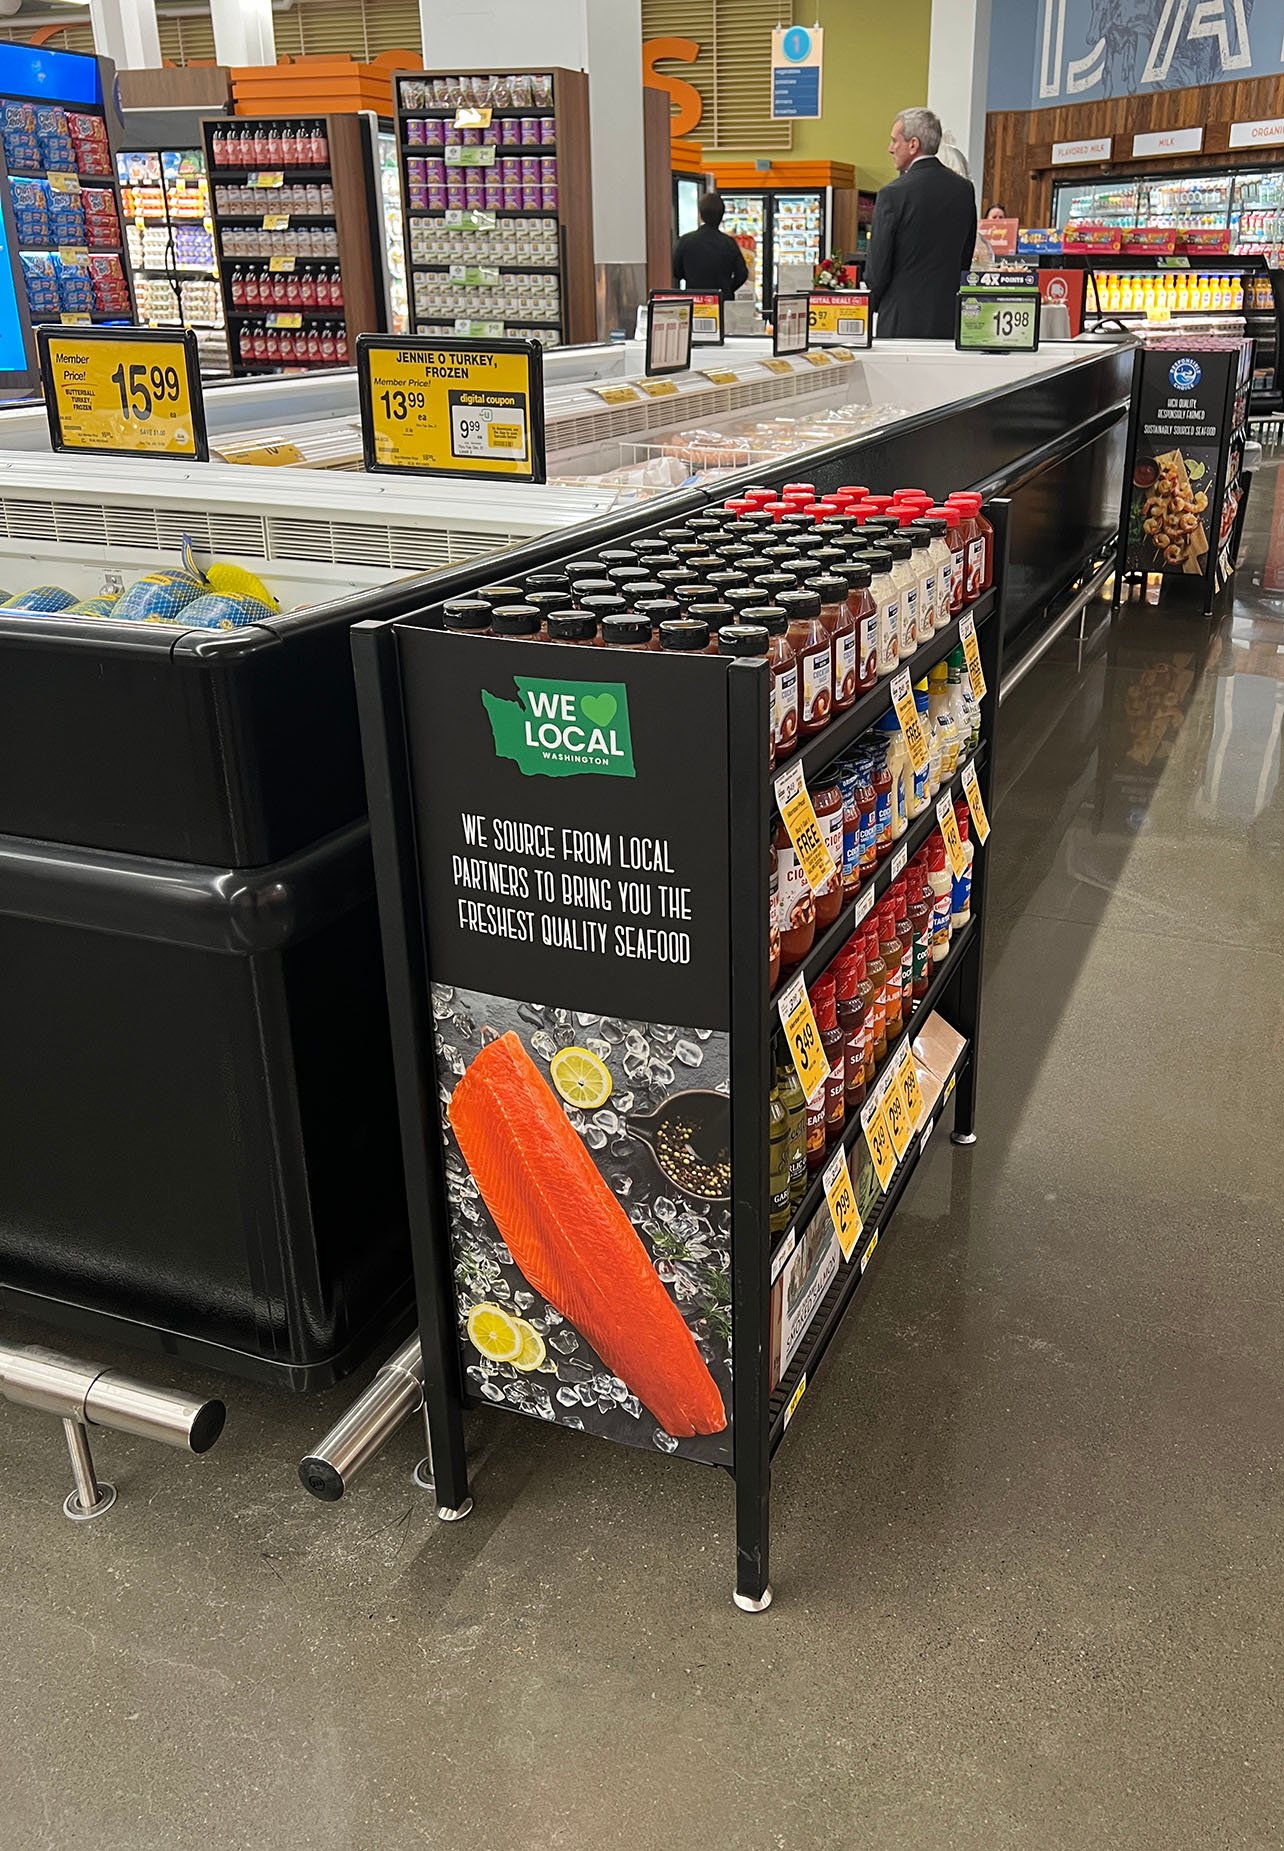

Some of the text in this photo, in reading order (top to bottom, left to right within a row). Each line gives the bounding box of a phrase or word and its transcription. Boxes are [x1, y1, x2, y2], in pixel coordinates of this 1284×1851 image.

[1158, 137, 1176, 148] MILK
[1057, 144, 1105, 158] FLAVORED MILK
[980, 273, 1001, 286] 4X
[56, 352, 90, 365] Member
[396, 352, 498, 369] JENNIE O TURKEY,
[63, 370, 86, 381] Price!
[425, 366, 469, 379] FROZEN
[374, 377, 431, 388] Member Price!
[460, 393, 515, 406] digital coupon
[1178, 399, 1198, 409] QUALITY
[418, 413, 427, 421] ea
[1186, 410, 1206, 420] FARMED
[1143, 424, 1216, 436] SUSTAINABLY SOURCED SEAFOOD
[527, 691, 577, 722] WE
[525, 720, 625, 757] LOCAL
[905, 719, 921, 747] FREE
[542, 751, 609, 766] WASHINGTON
[461, 812, 675, 874] WE SOURCE FROM LOCAL
[796, 823, 820, 859] FREE
[452, 854, 693, 921] PARTNERS TO BRING YOU THE
[457, 898, 691, 965] FRESHEST QUALITY SEAFOOD
